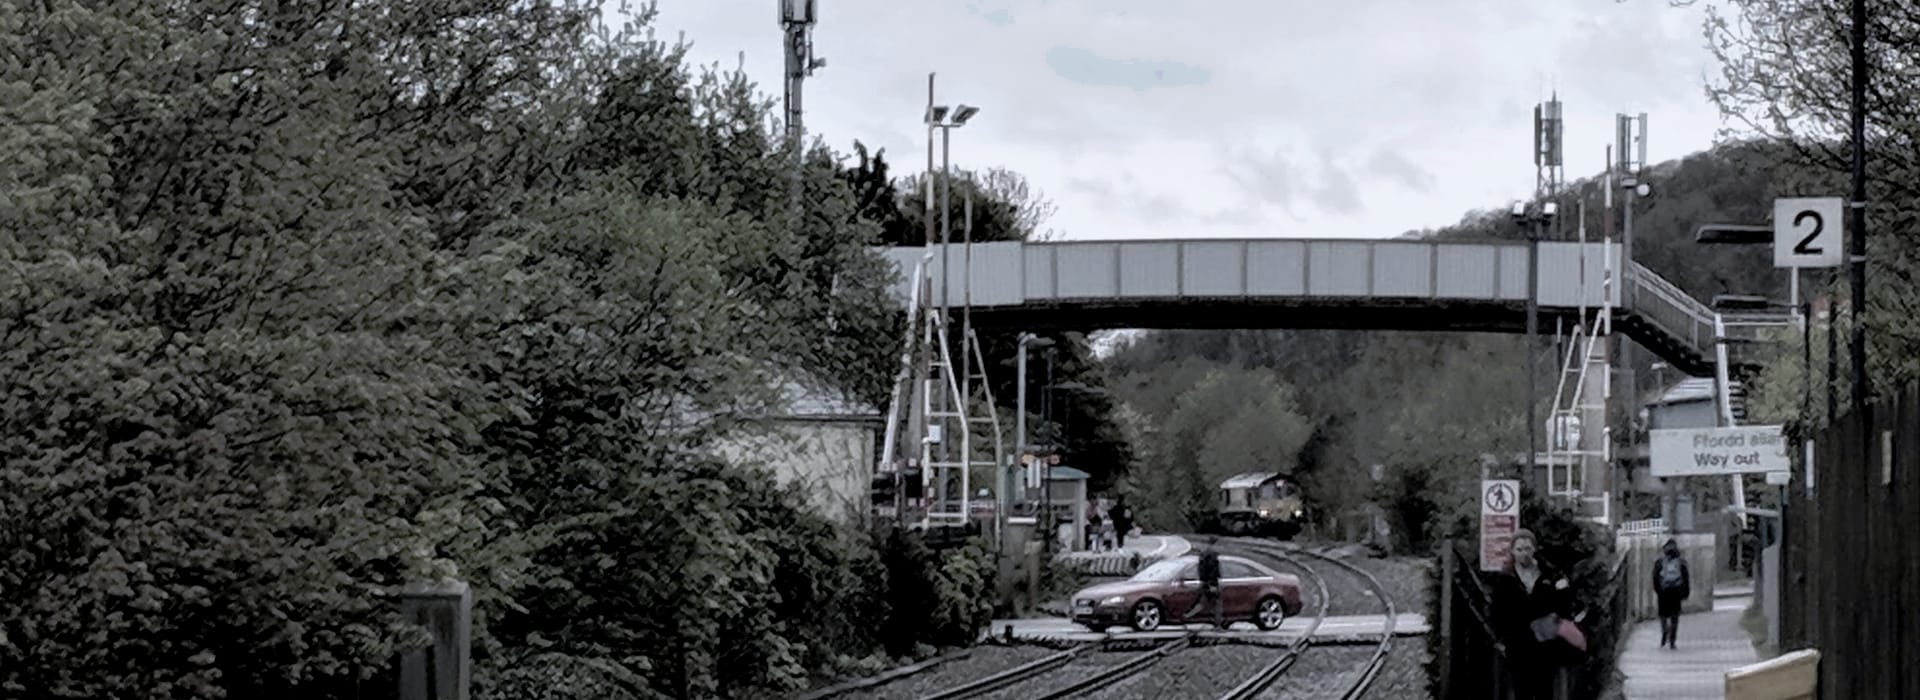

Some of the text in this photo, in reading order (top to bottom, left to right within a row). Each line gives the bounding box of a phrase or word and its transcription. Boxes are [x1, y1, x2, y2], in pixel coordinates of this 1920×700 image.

[1793, 209, 1824, 255] 2
[1694, 451, 1760, 468] Way out
